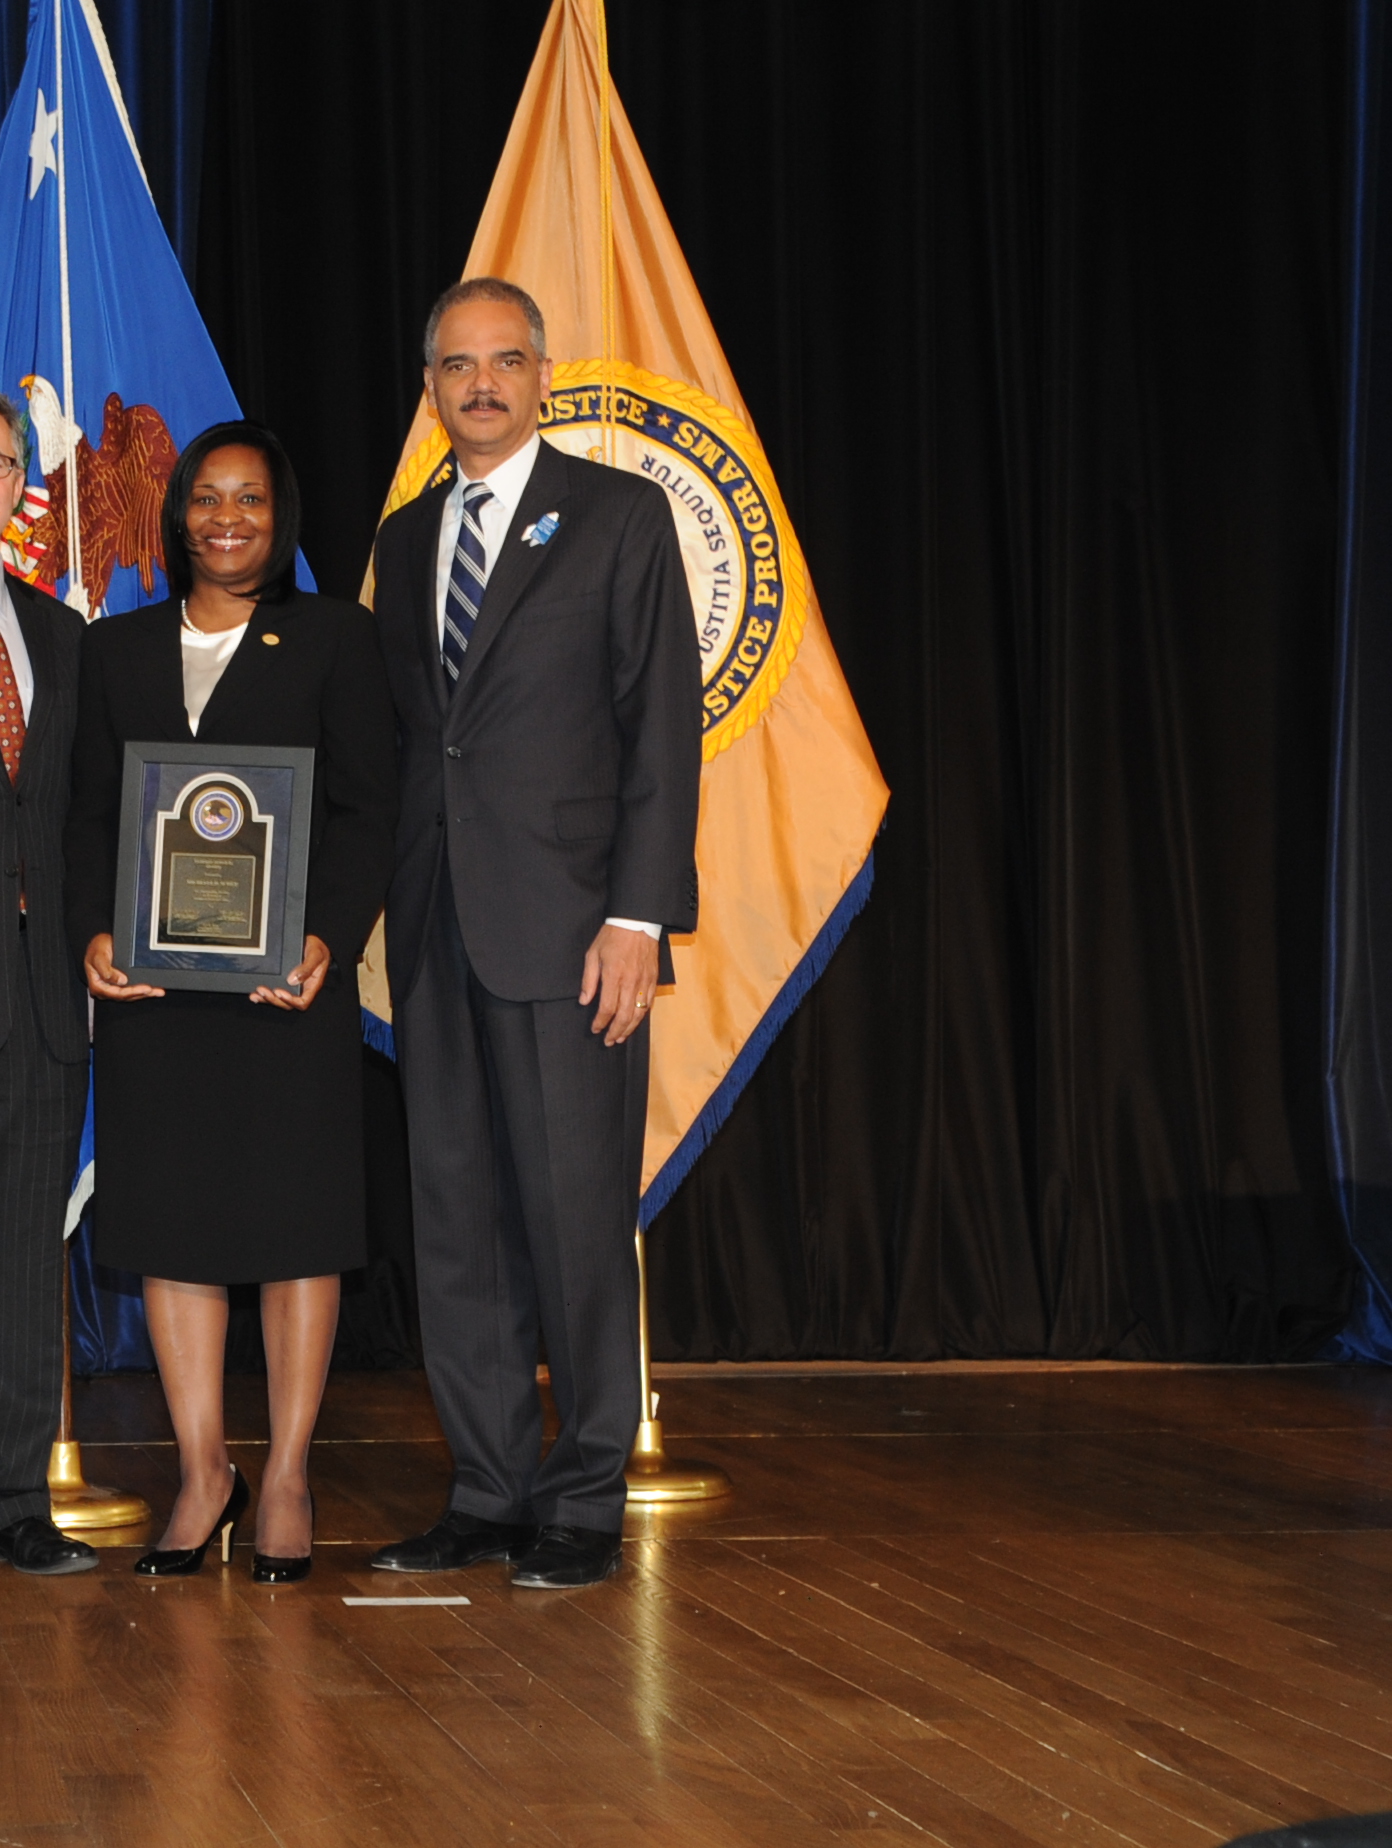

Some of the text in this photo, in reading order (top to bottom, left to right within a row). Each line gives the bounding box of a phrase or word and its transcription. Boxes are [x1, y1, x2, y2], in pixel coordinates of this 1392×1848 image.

[538, 390, 648, 426] USTICE
[640, 454, 732, 654] USTITIA SEQUITUR
[672, 421, 778, 729] STICE PROGRAMS
